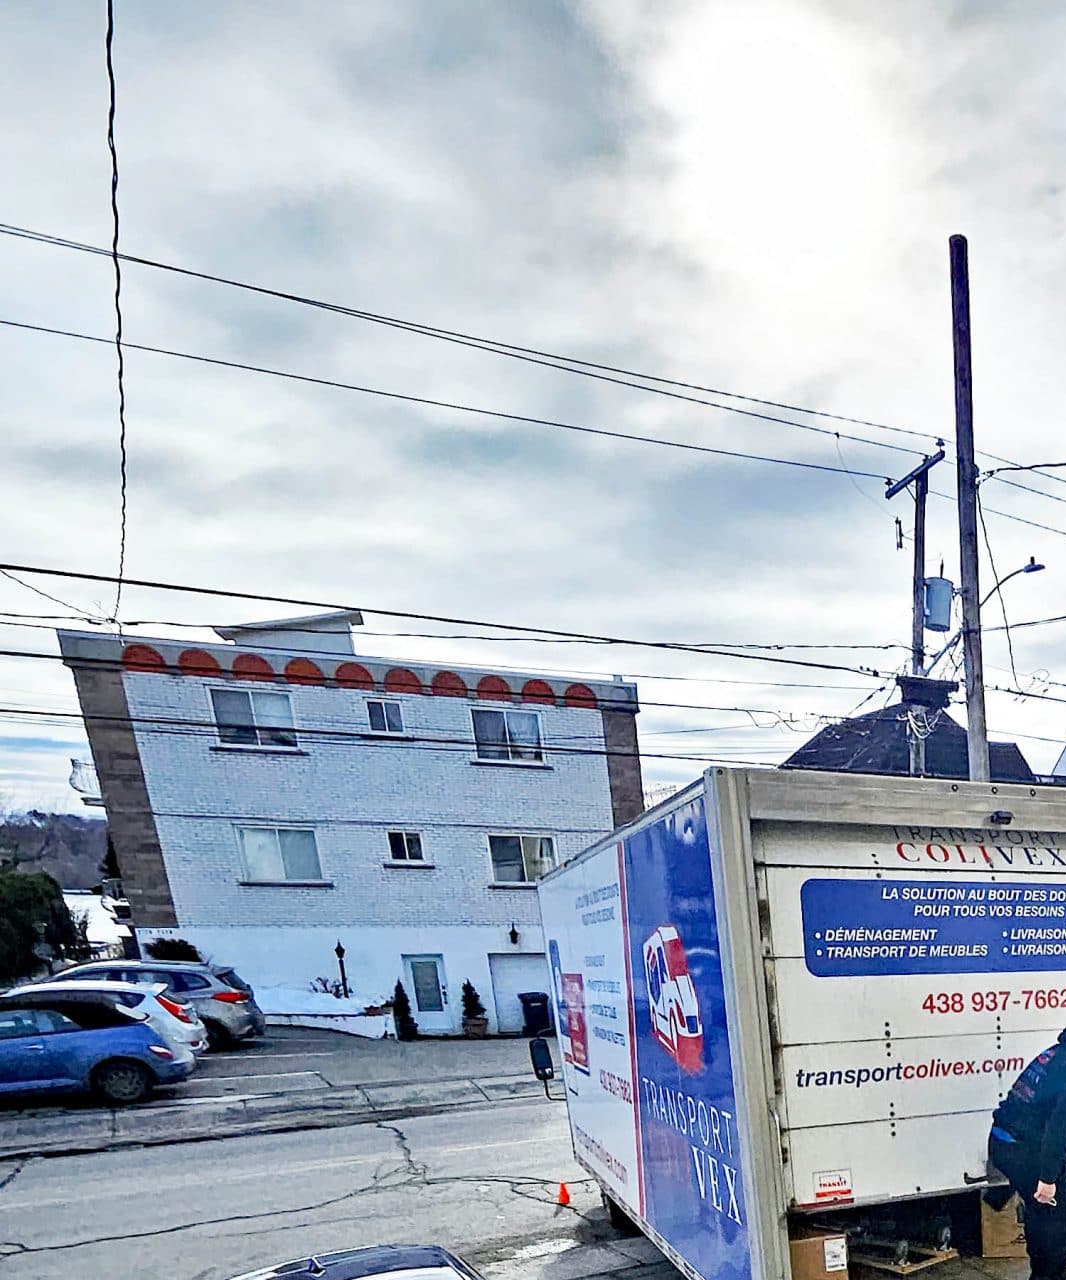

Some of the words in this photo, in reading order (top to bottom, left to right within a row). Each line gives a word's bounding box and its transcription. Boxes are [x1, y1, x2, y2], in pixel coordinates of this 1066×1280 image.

[892, 825, 1060, 846] TRANSPORT
[881, 887, 899, 900] LA
[901, 887, 966, 901] SOLUTION
[968, 888, 986, 901] AU
[988, 889, 1021, 902] BOUT
[1023, 890, 1047, 902] DES
[914, 904, 951, 917] POUR
[953, 905, 986, 917] TOUS
[989, 905, 1012, 917] VOS
[1015, 905, 1066, 918] BESOINS
[825, 926, 938, 942] DÉMÉNAGEMENT
[826, 945, 908, 959] TRANSPORT
[909, 945, 926, 958] DE
[929, 944, 989, 958] MEUBLES
[922, 992, 965, 1014] 438
[795, 1056, 1025, 1089] transportcolivex.com
[642, 1077, 732, 1158] TRANSPORT
